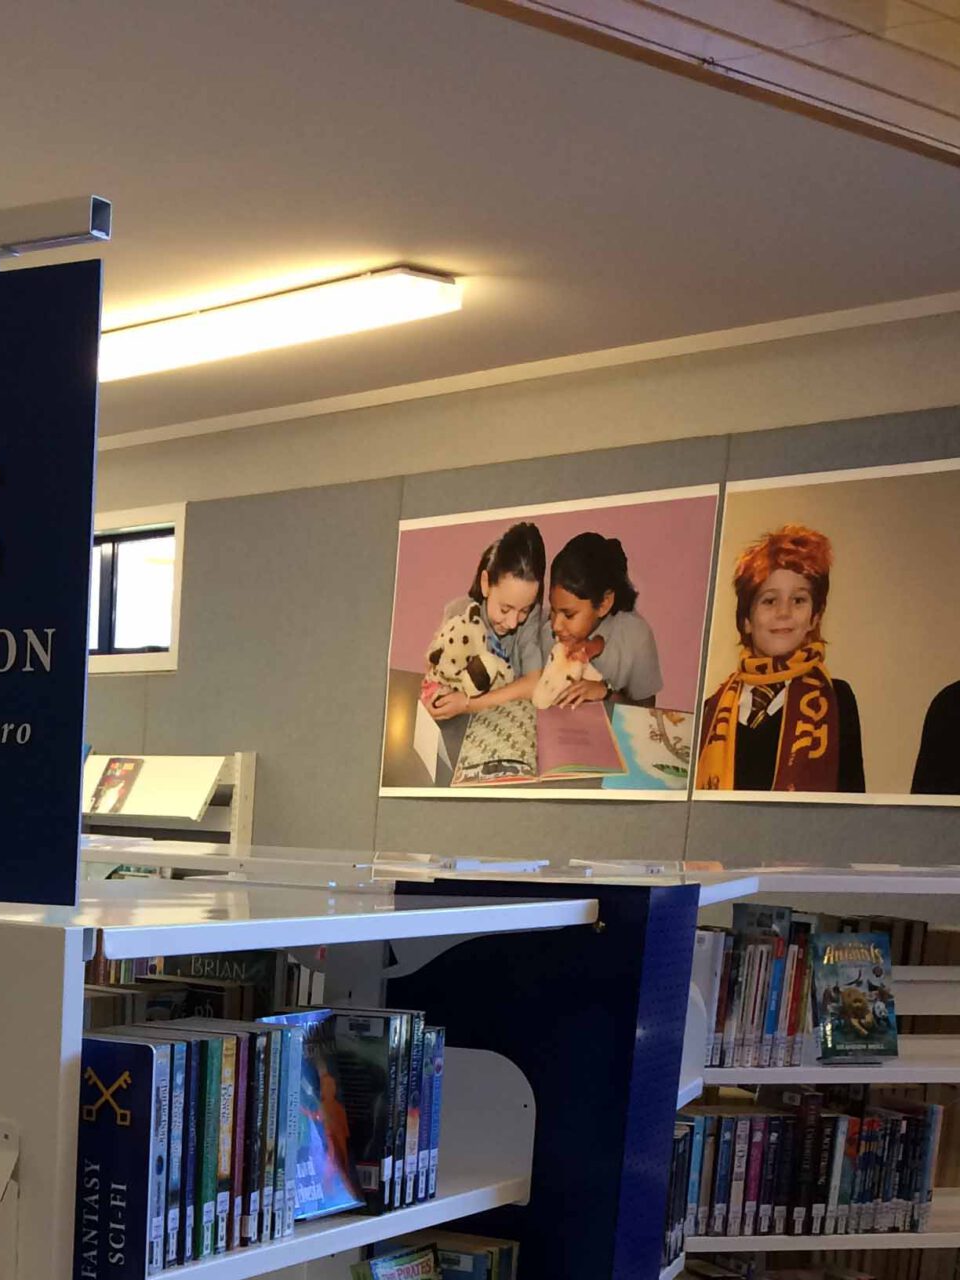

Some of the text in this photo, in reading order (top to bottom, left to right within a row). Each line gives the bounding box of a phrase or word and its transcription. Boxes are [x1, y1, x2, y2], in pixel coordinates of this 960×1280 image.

[190, 954, 247, 980] BRIAN
[81, 1157, 100, 1280] FANTASY
[108, 1181, 127, 1266] SCI-FI
[396, 1260, 433, 1280] PIRATES
